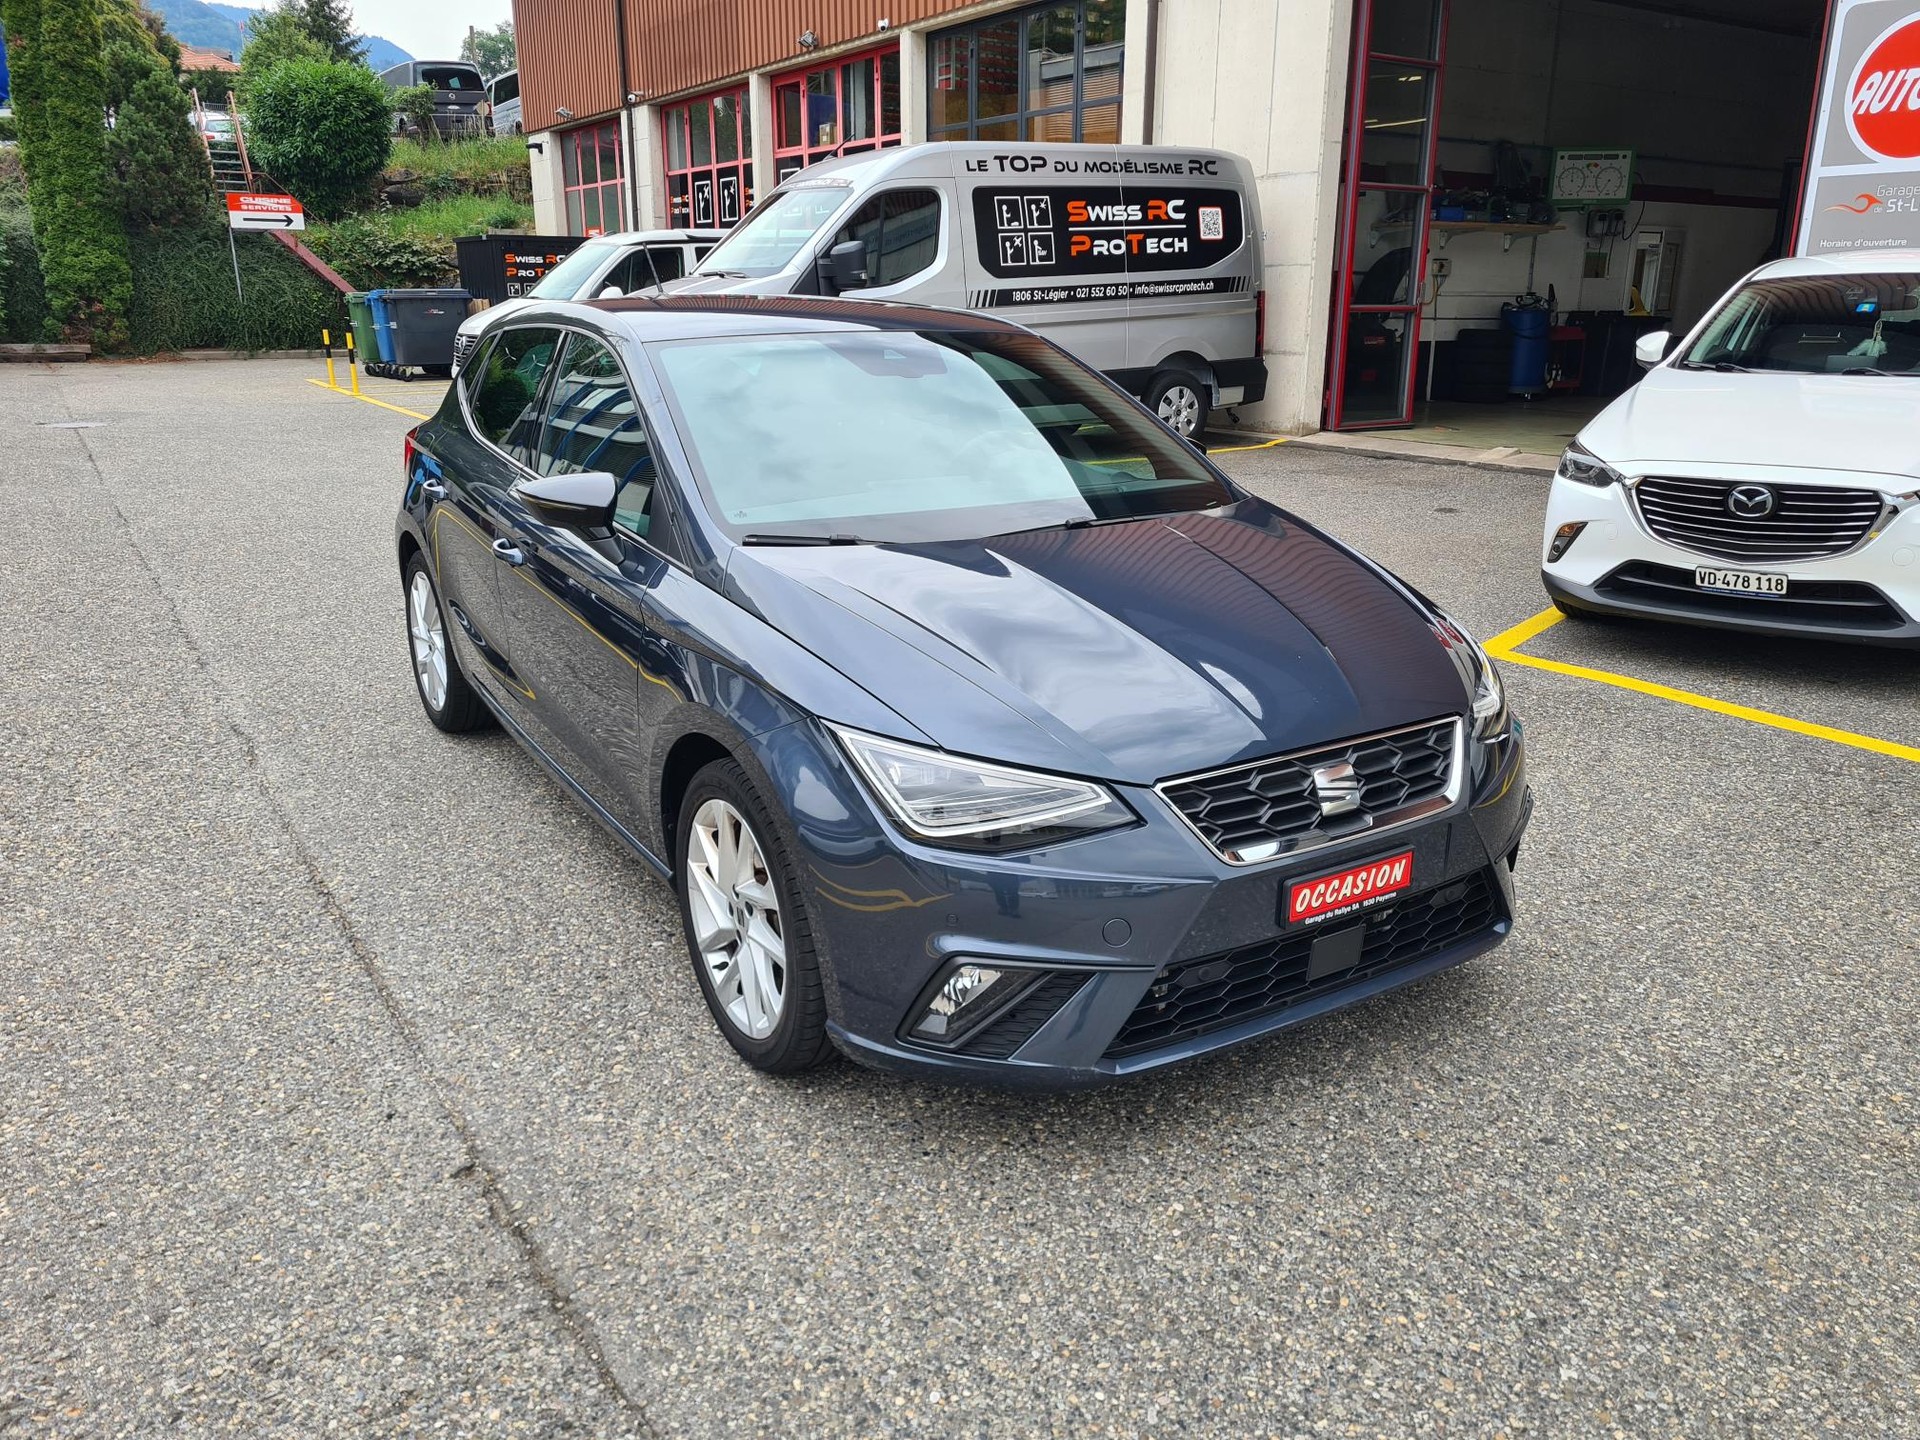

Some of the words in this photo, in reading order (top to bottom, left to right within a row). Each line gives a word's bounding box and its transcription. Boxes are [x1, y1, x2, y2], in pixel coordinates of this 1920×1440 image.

[966, 160, 989, 172] LE
[993, 155, 1047, 172] TOP
[1054, 161, 1078, 173] DU
[1084, 159, 1184, 175] MODÉLISME
[1188, 159, 1219, 175] RC
[1877, 185, 1920, 199] Garage
[240, 197, 291, 205] CUISINE
[1147, 199, 1186, 220] RC
[1820, 239, 1852, 248] Horaire
[1854, 238, 1908, 248] d'ouverture
[1012, 291, 1032, 302] 1806
[1033, 288, 1069, 302] St-Légier
[1076, 287, 1090, 298] 021
[1091, 286, 1105, 297] 552
[1106, 286, 1116, 296] 60
[1117, 285, 1128, 296] 50
[1134, 280, 1215, 295] info@swissrcprotech.ch
[1295, 859, 1407, 913] OCCASION
[1304, 914, 1325, 925] Garage
